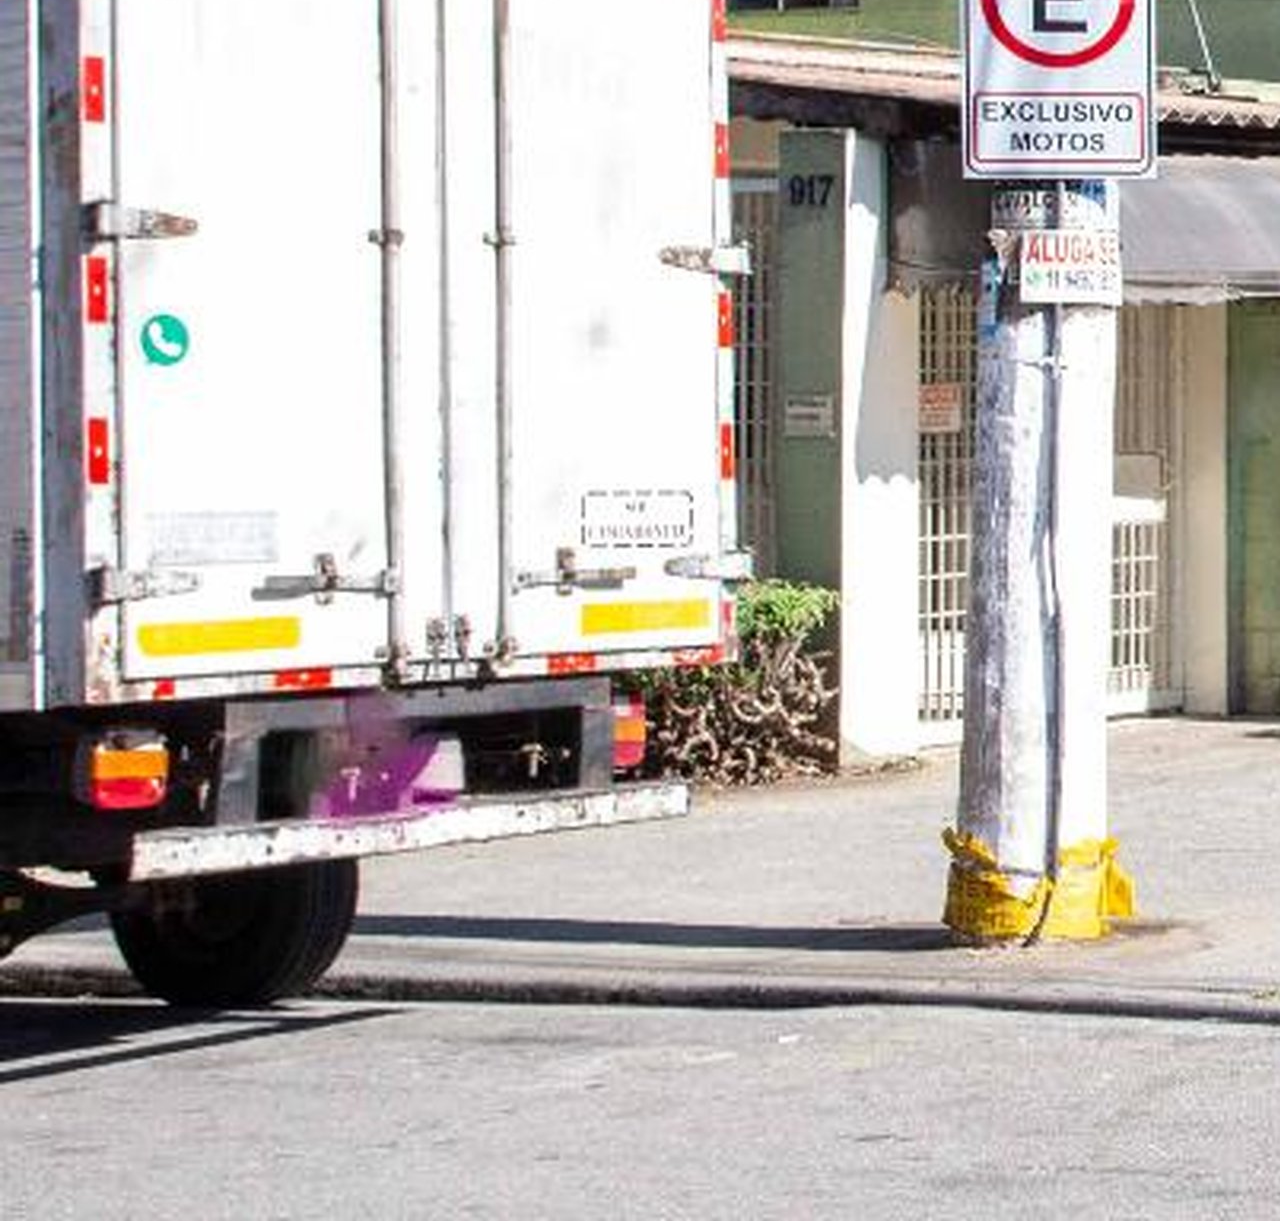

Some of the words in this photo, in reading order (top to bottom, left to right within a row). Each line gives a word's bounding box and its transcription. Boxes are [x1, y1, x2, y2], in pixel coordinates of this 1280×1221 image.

[981, 100, 1134, 123] EXCLUSIVO
[1010, 132, 1105, 153] MOTOS
[788, 174, 834, 207] 917
